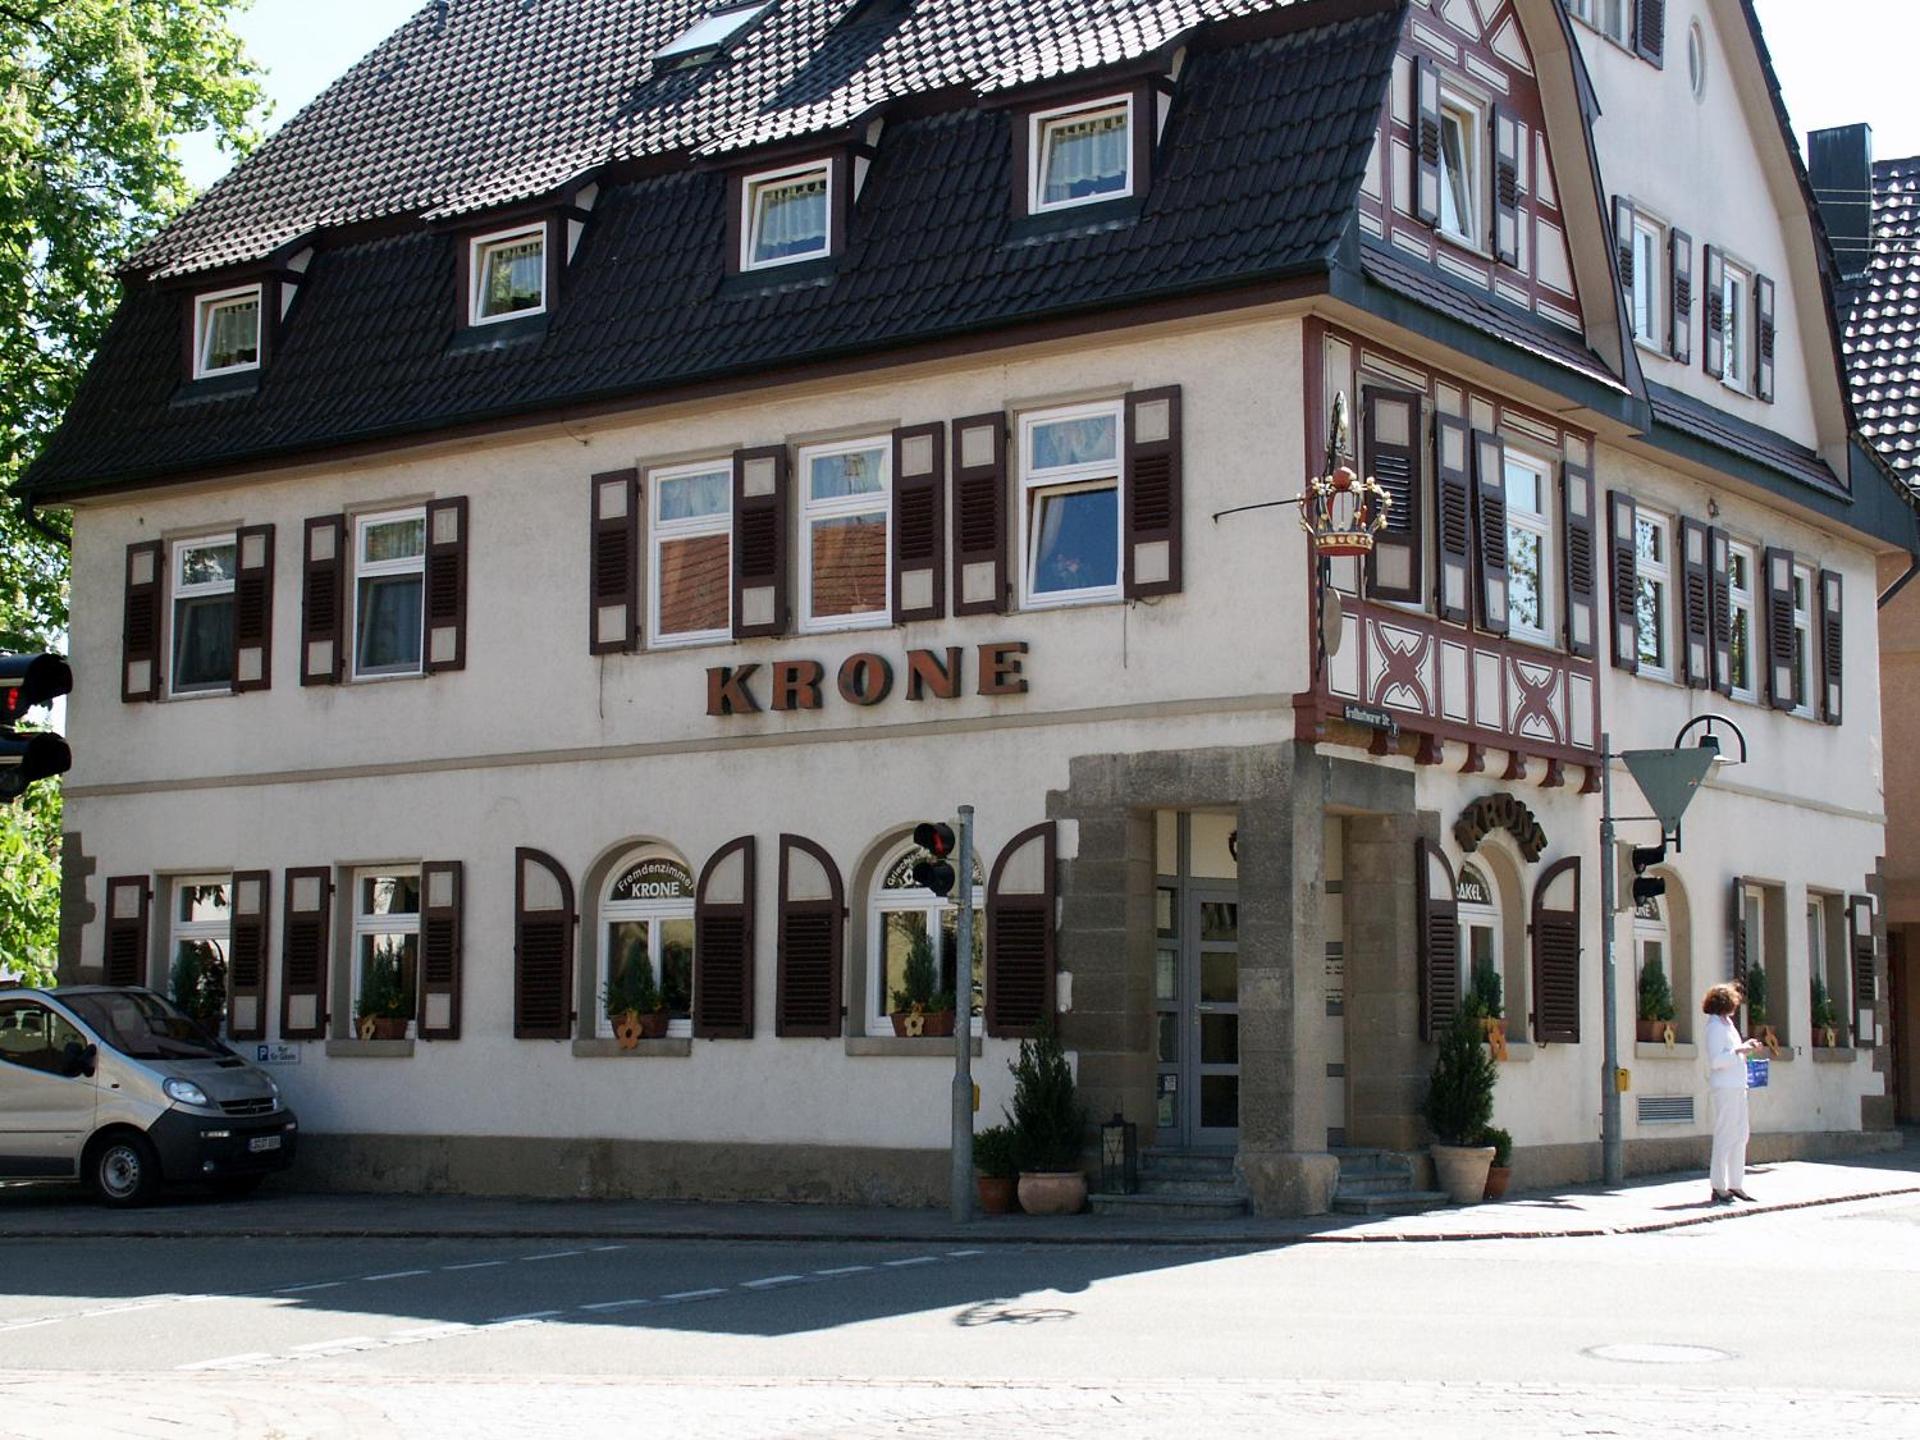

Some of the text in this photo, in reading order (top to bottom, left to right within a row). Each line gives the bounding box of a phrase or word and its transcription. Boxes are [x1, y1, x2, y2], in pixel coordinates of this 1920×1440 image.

[706, 641, 1029, 716] KRONE
[1453, 792, 1548, 863] KRONE
[617, 863, 695, 893] Fremdenzimmer
[631, 881, 680, 897] KRONE
[1457, 883, 1482, 901] AKEL
